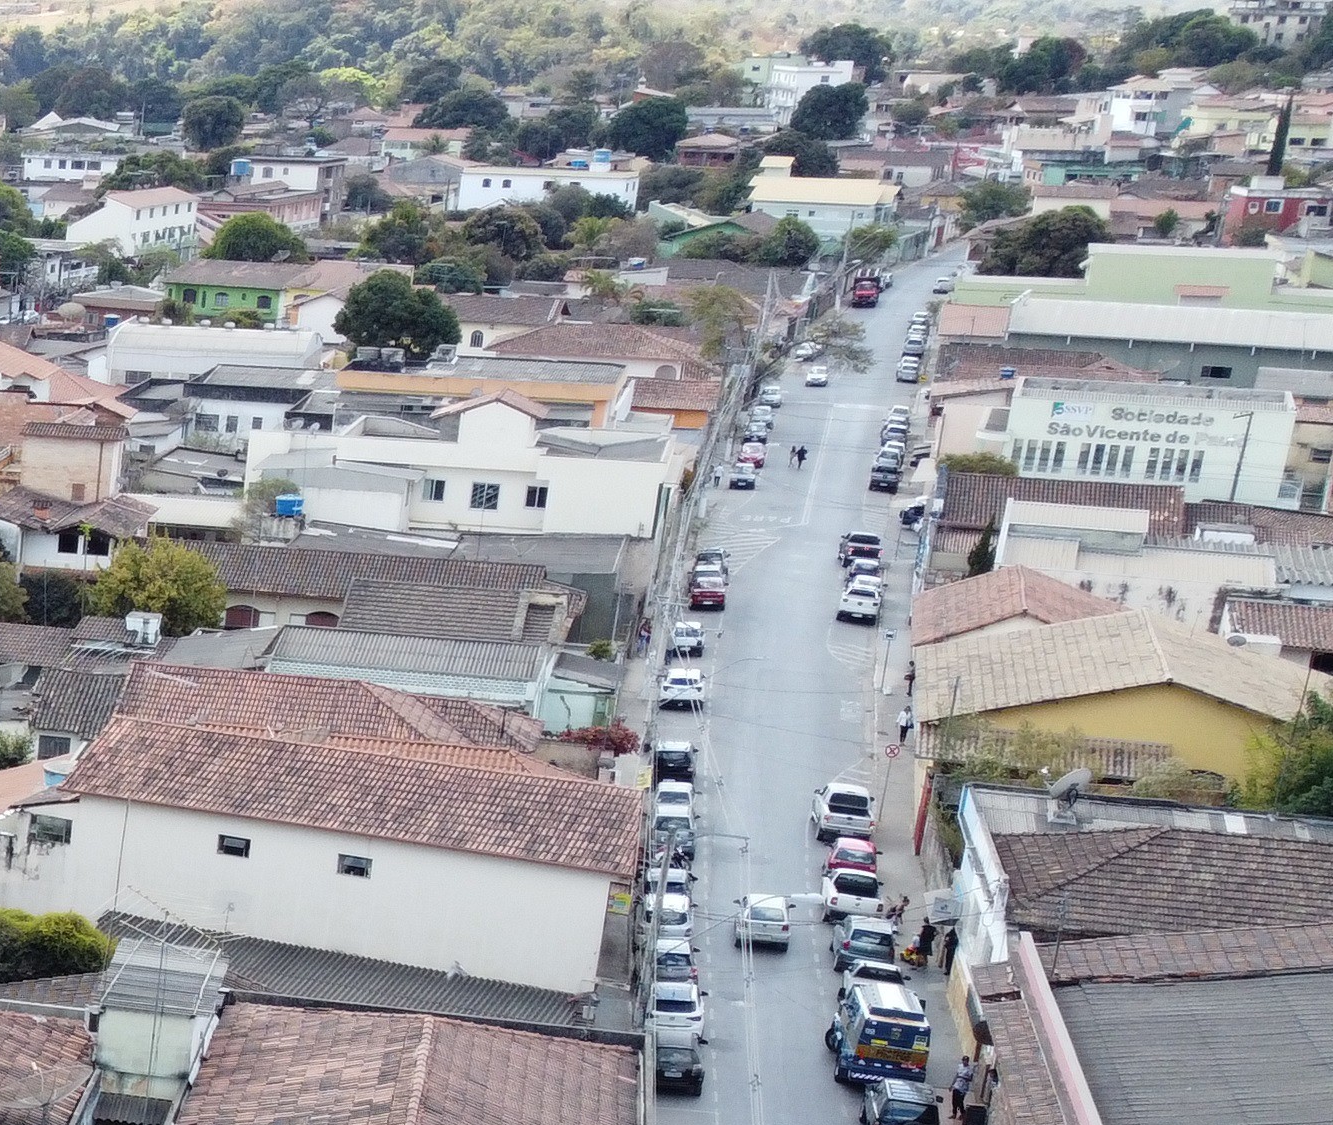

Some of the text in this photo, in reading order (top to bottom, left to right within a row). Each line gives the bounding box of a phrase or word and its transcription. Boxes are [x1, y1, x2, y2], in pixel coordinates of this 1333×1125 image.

[1111, 407, 1215, 427] Sociedade
[1047, 422, 1083, 437] São
[1085, 425, 1162, 443] Vicente
[1165, 431, 1189, 445] de
